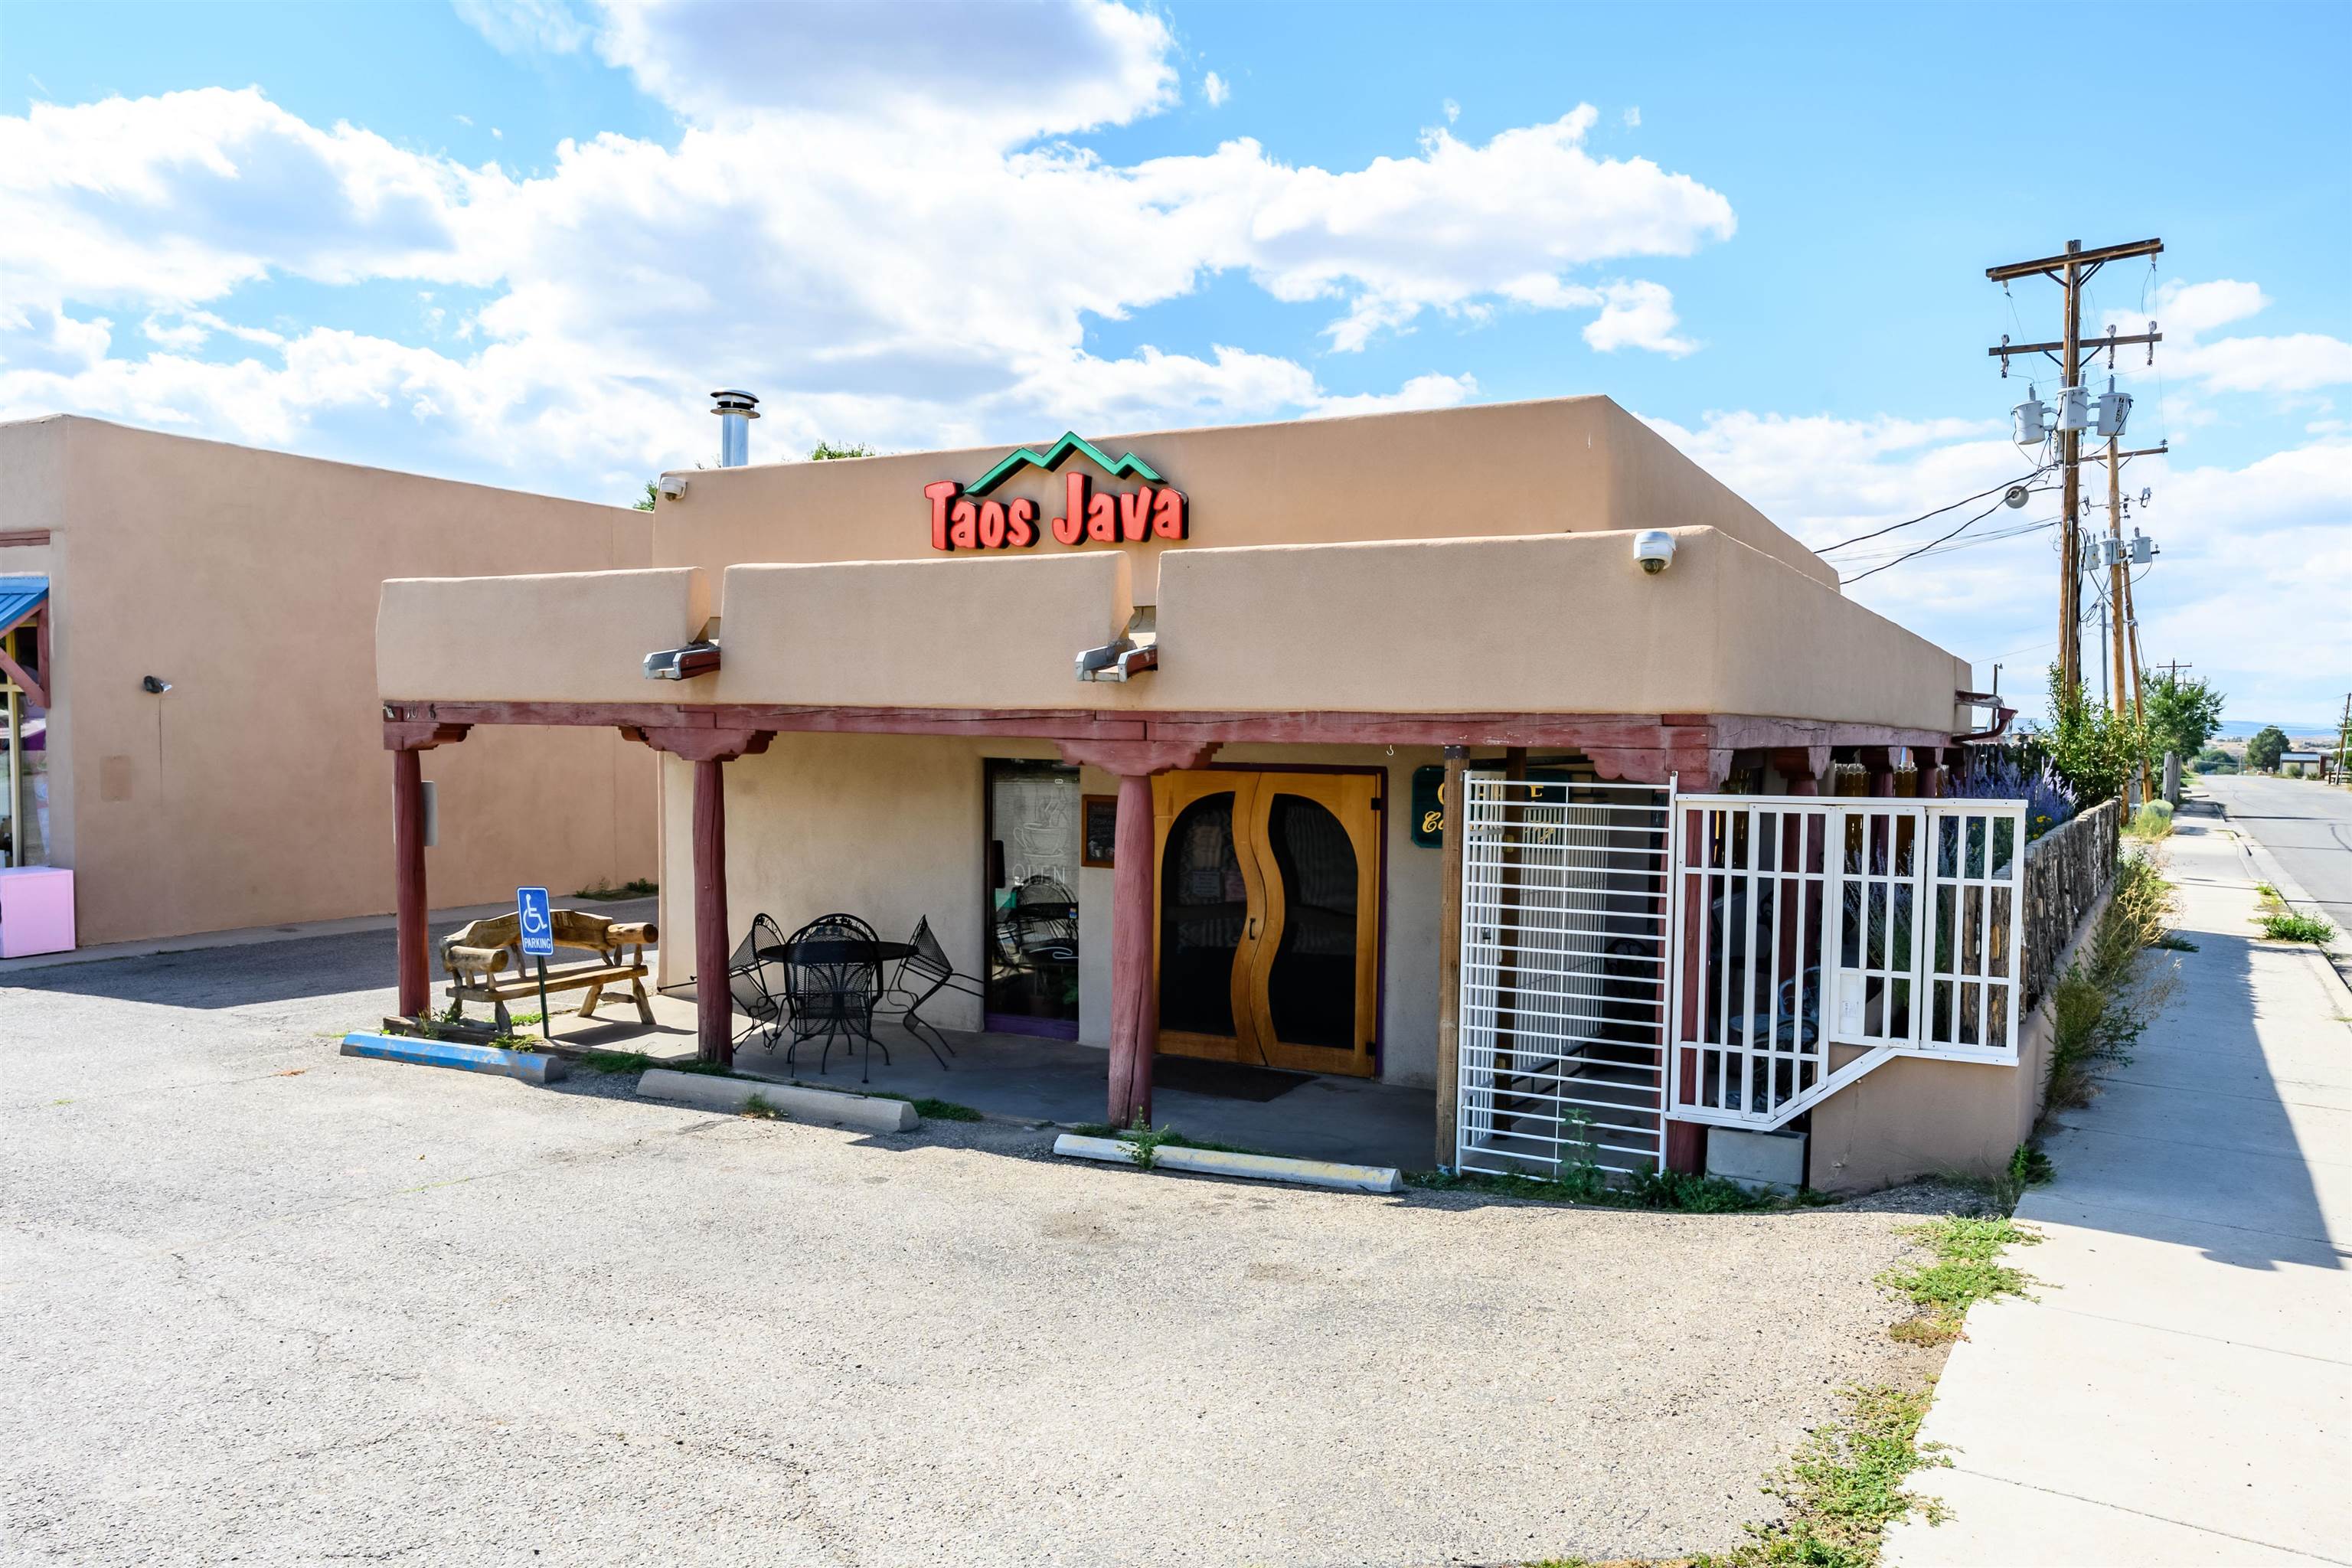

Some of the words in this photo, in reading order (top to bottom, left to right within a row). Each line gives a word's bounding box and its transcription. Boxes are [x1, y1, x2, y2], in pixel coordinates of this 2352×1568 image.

[924, 480, 1039, 551] Taos
[1052, 471, 1188, 545] Java
[524, 937, 551, 949] PARKING
